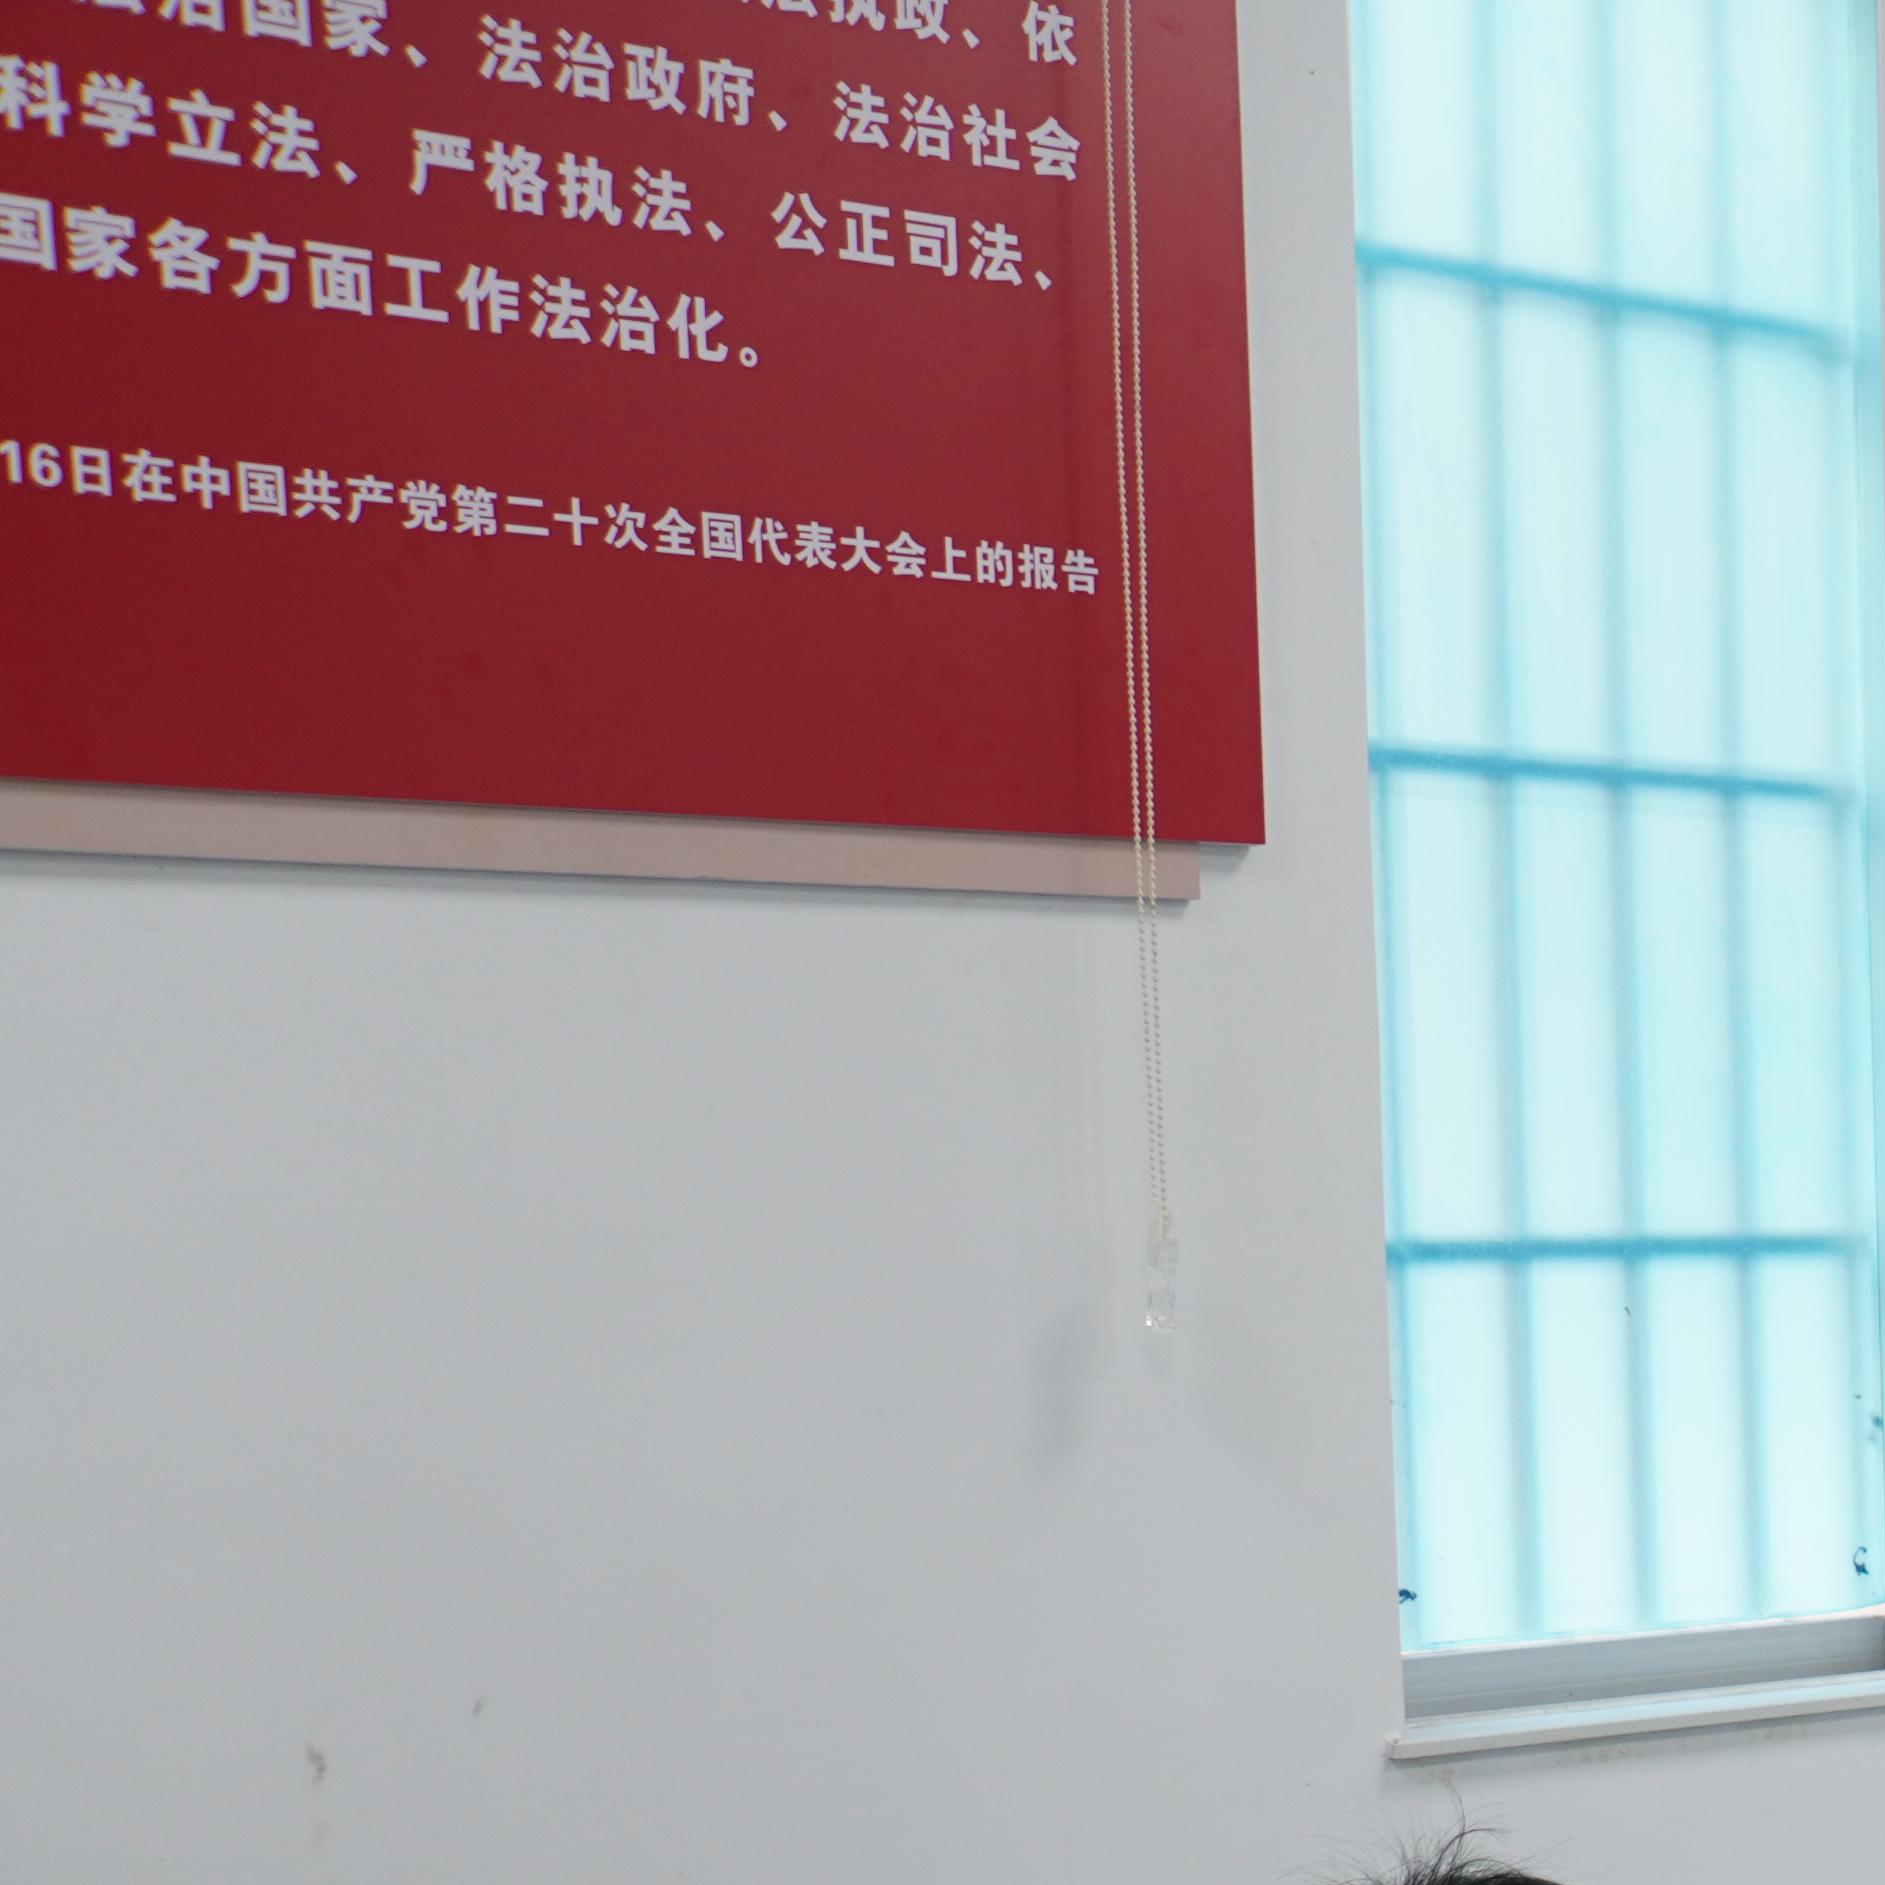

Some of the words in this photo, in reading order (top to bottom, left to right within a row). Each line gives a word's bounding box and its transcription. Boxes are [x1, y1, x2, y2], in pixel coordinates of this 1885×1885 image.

[0, 54, 1052, 291] 科学立法、严格执法、公正司法、
[72, 0, 1081, 181] 国家、法治政府、法治社会
[0, 192, 758, 368] 国家各方面工作法治化。
[0, 440, 1099, 595] 16日在中国共产党第二十次全国代表大会上的报告
